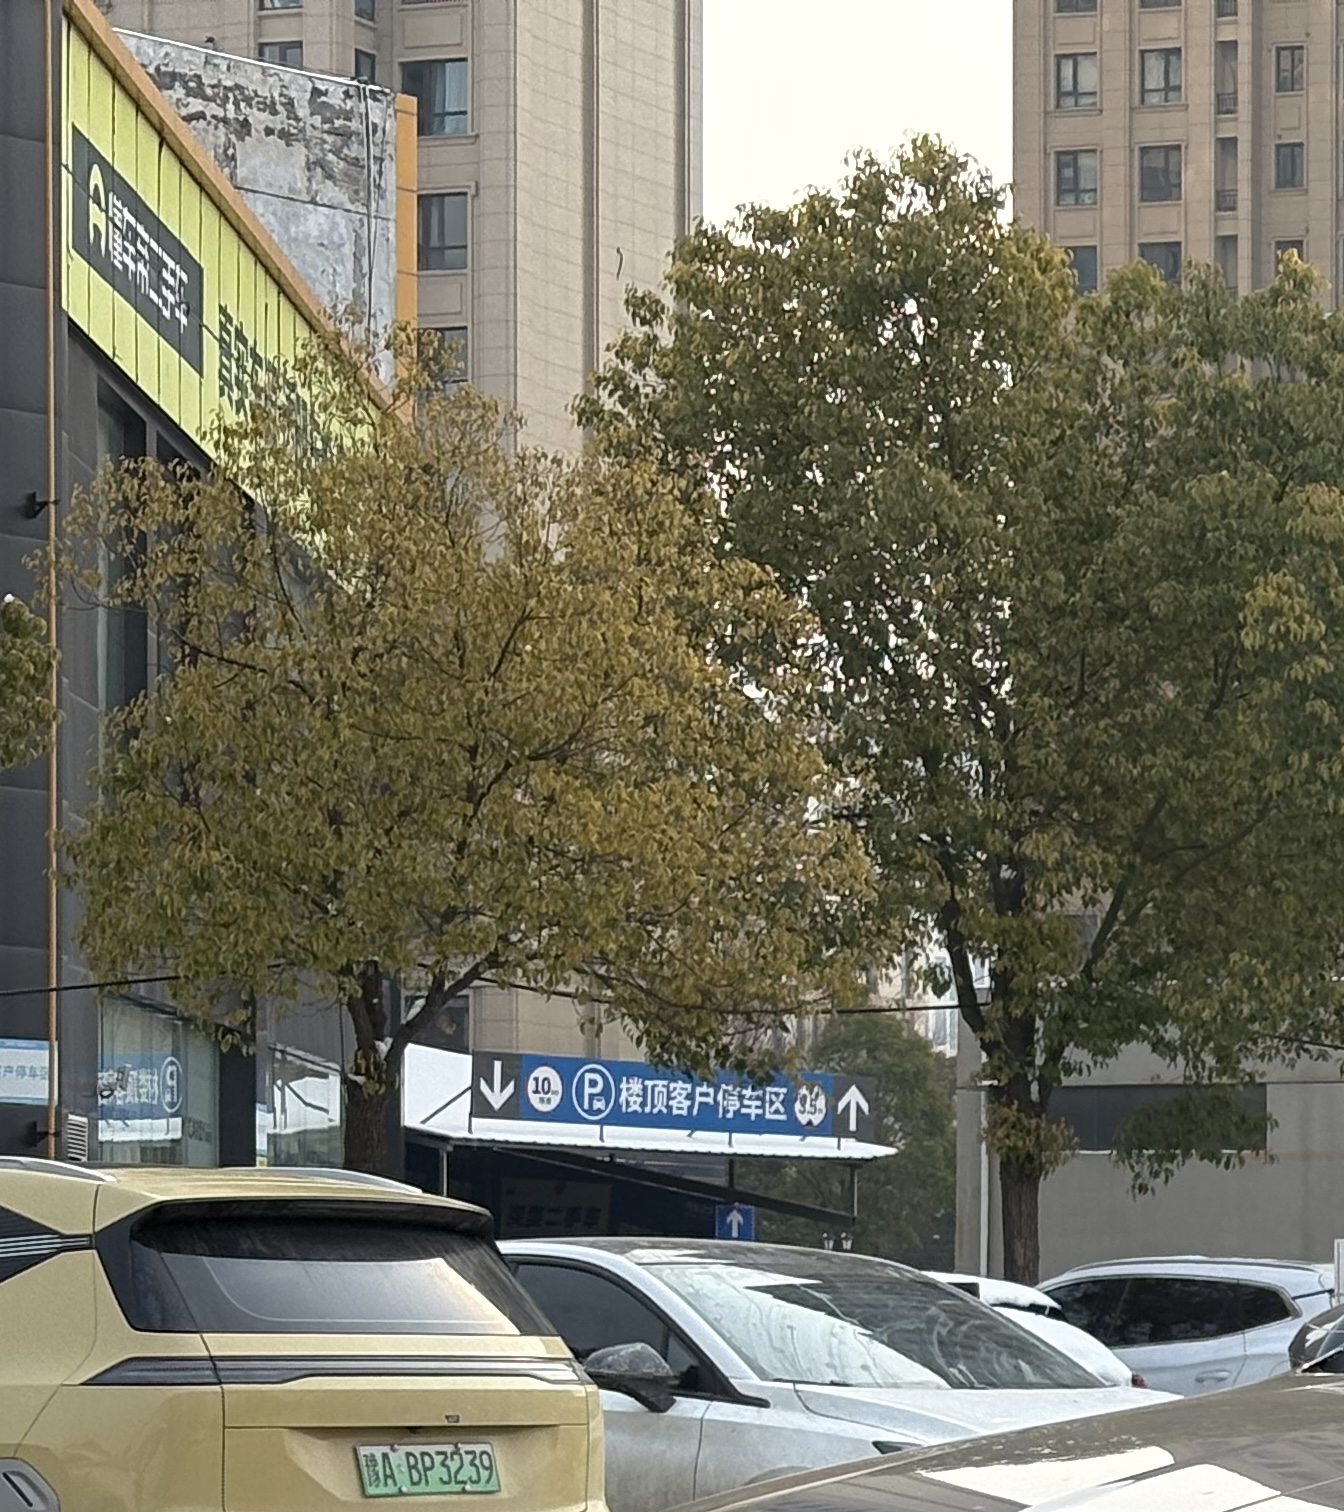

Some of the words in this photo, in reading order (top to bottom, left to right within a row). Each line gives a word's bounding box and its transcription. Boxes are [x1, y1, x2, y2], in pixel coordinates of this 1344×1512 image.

[532, 1076, 551, 1095] 10
[619, 1077, 788, 1120] 楼顶客户停车区
